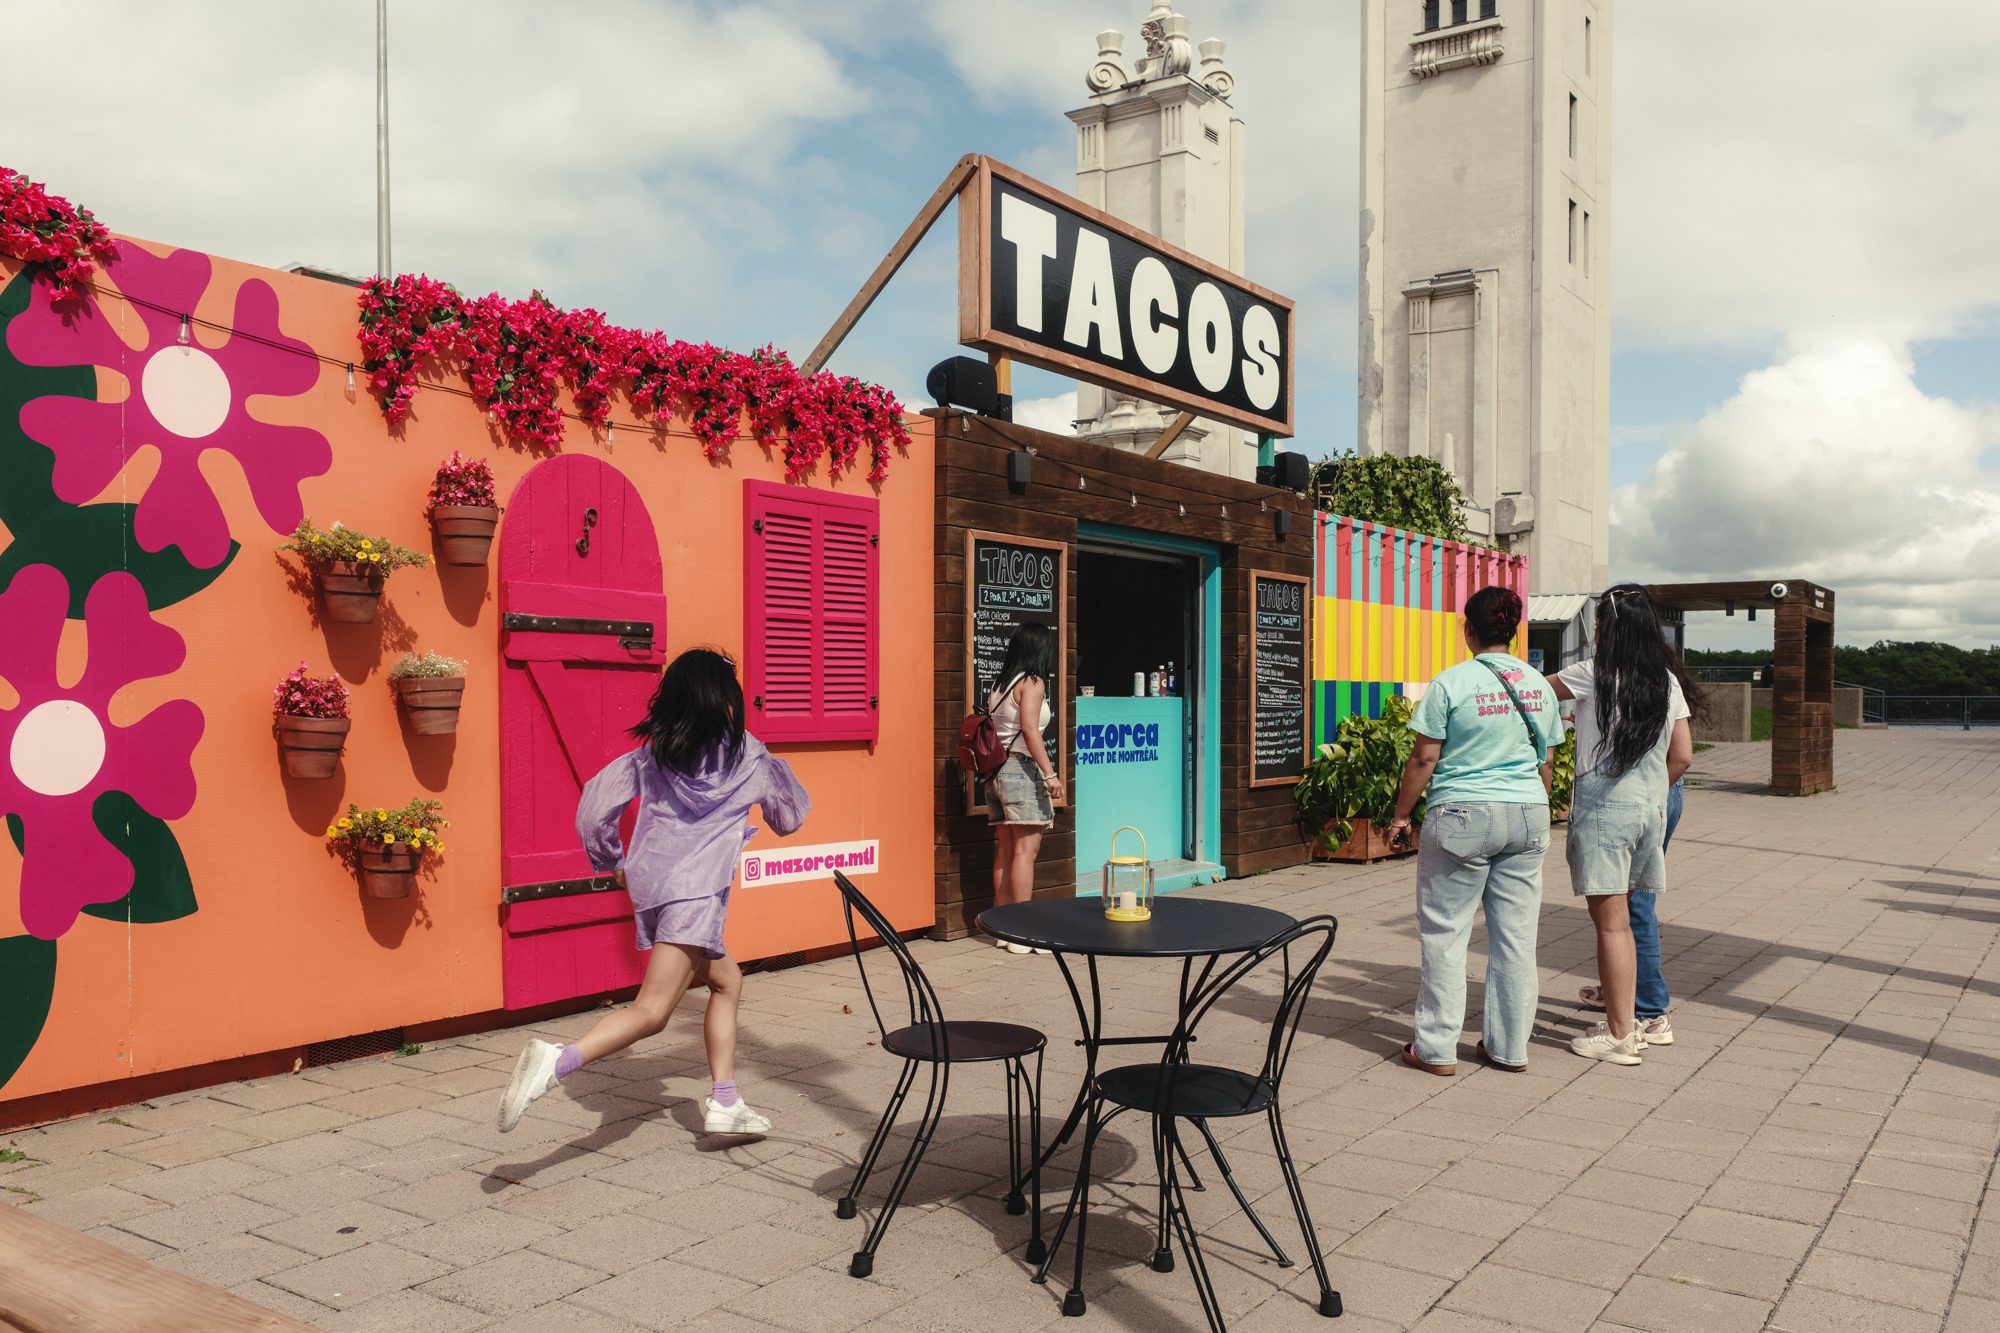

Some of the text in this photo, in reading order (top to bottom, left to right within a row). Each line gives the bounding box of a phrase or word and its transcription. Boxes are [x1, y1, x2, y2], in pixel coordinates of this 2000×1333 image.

[1001, 192, 1280, 411] TACOS
[980, 547, 1053, 589] TACOS
[983, 589, 989, 603] 2
[1020, 591, 1026, 606] 3
[1257, 583, 1300, 611] TACOS
[1475, 692, 1496, 704] IT'S
[1519, 689, 1542, 700] EASY
[1478, 704, 1510, 716] BEING
[1076, 723, 1159, 749] azorca
[1106, 750, 1117, 763] DE
[1118, 746, 1159, 763] MONTRÉAL
[764, 845, 875, 877] mazorca.mtl
